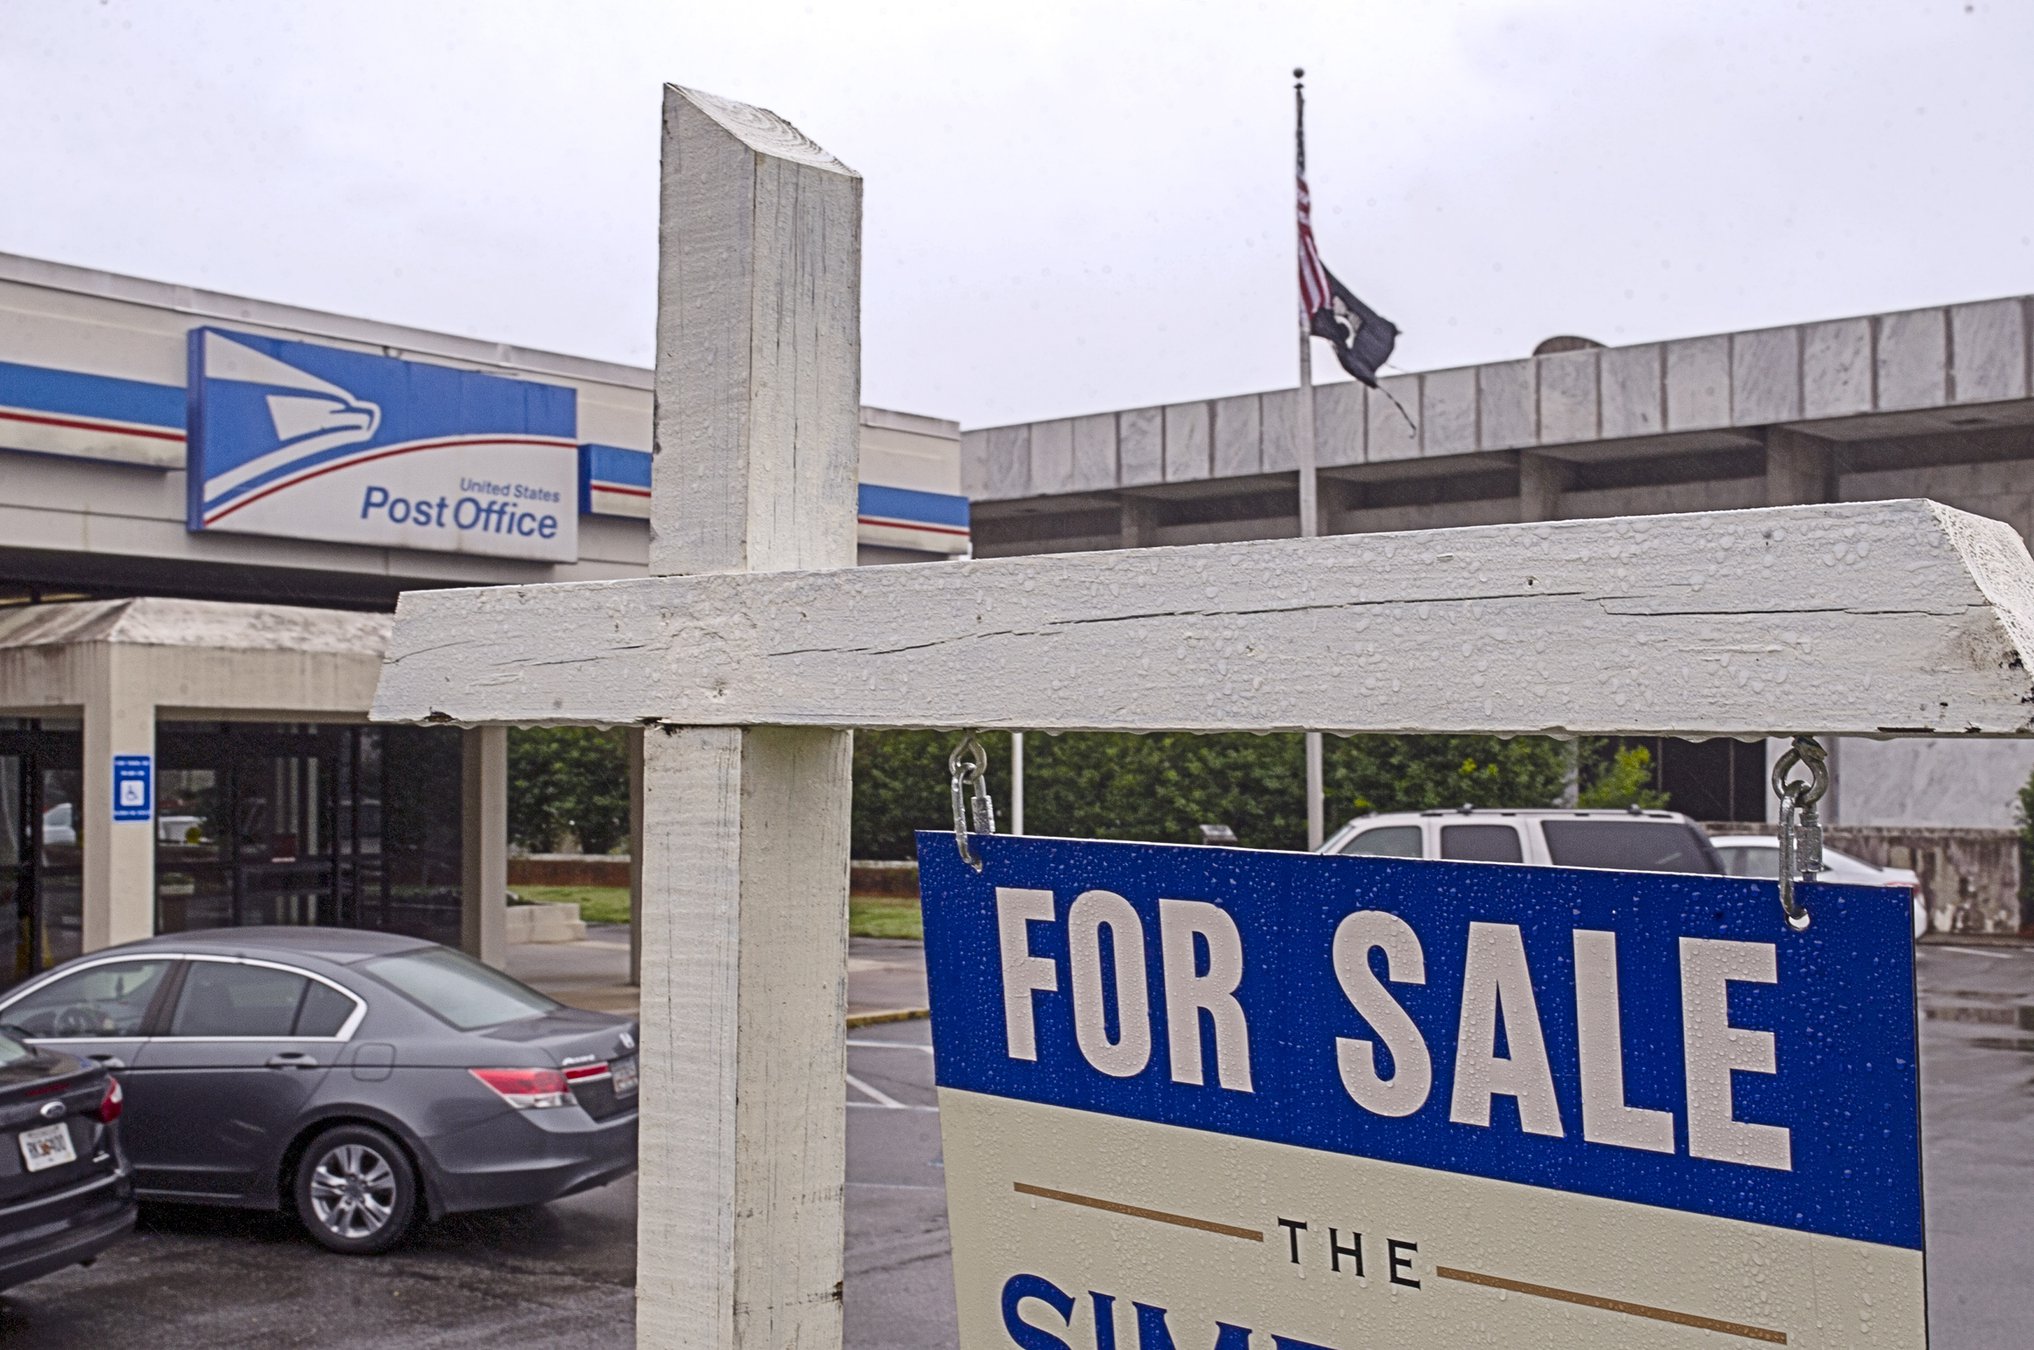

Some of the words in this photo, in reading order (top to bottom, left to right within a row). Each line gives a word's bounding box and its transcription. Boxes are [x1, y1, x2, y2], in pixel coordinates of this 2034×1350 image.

[360, 485, 448, 528] Post
[453, 496, 558, 539] Office
[459, 477, 511, 497] United
[513, 483, 561, 502] States
[995, 886, 1255, 1093] FOR
[1332, 910, 1793, 1171] SALE
[1277, 1216, 1422, 1290] THE
